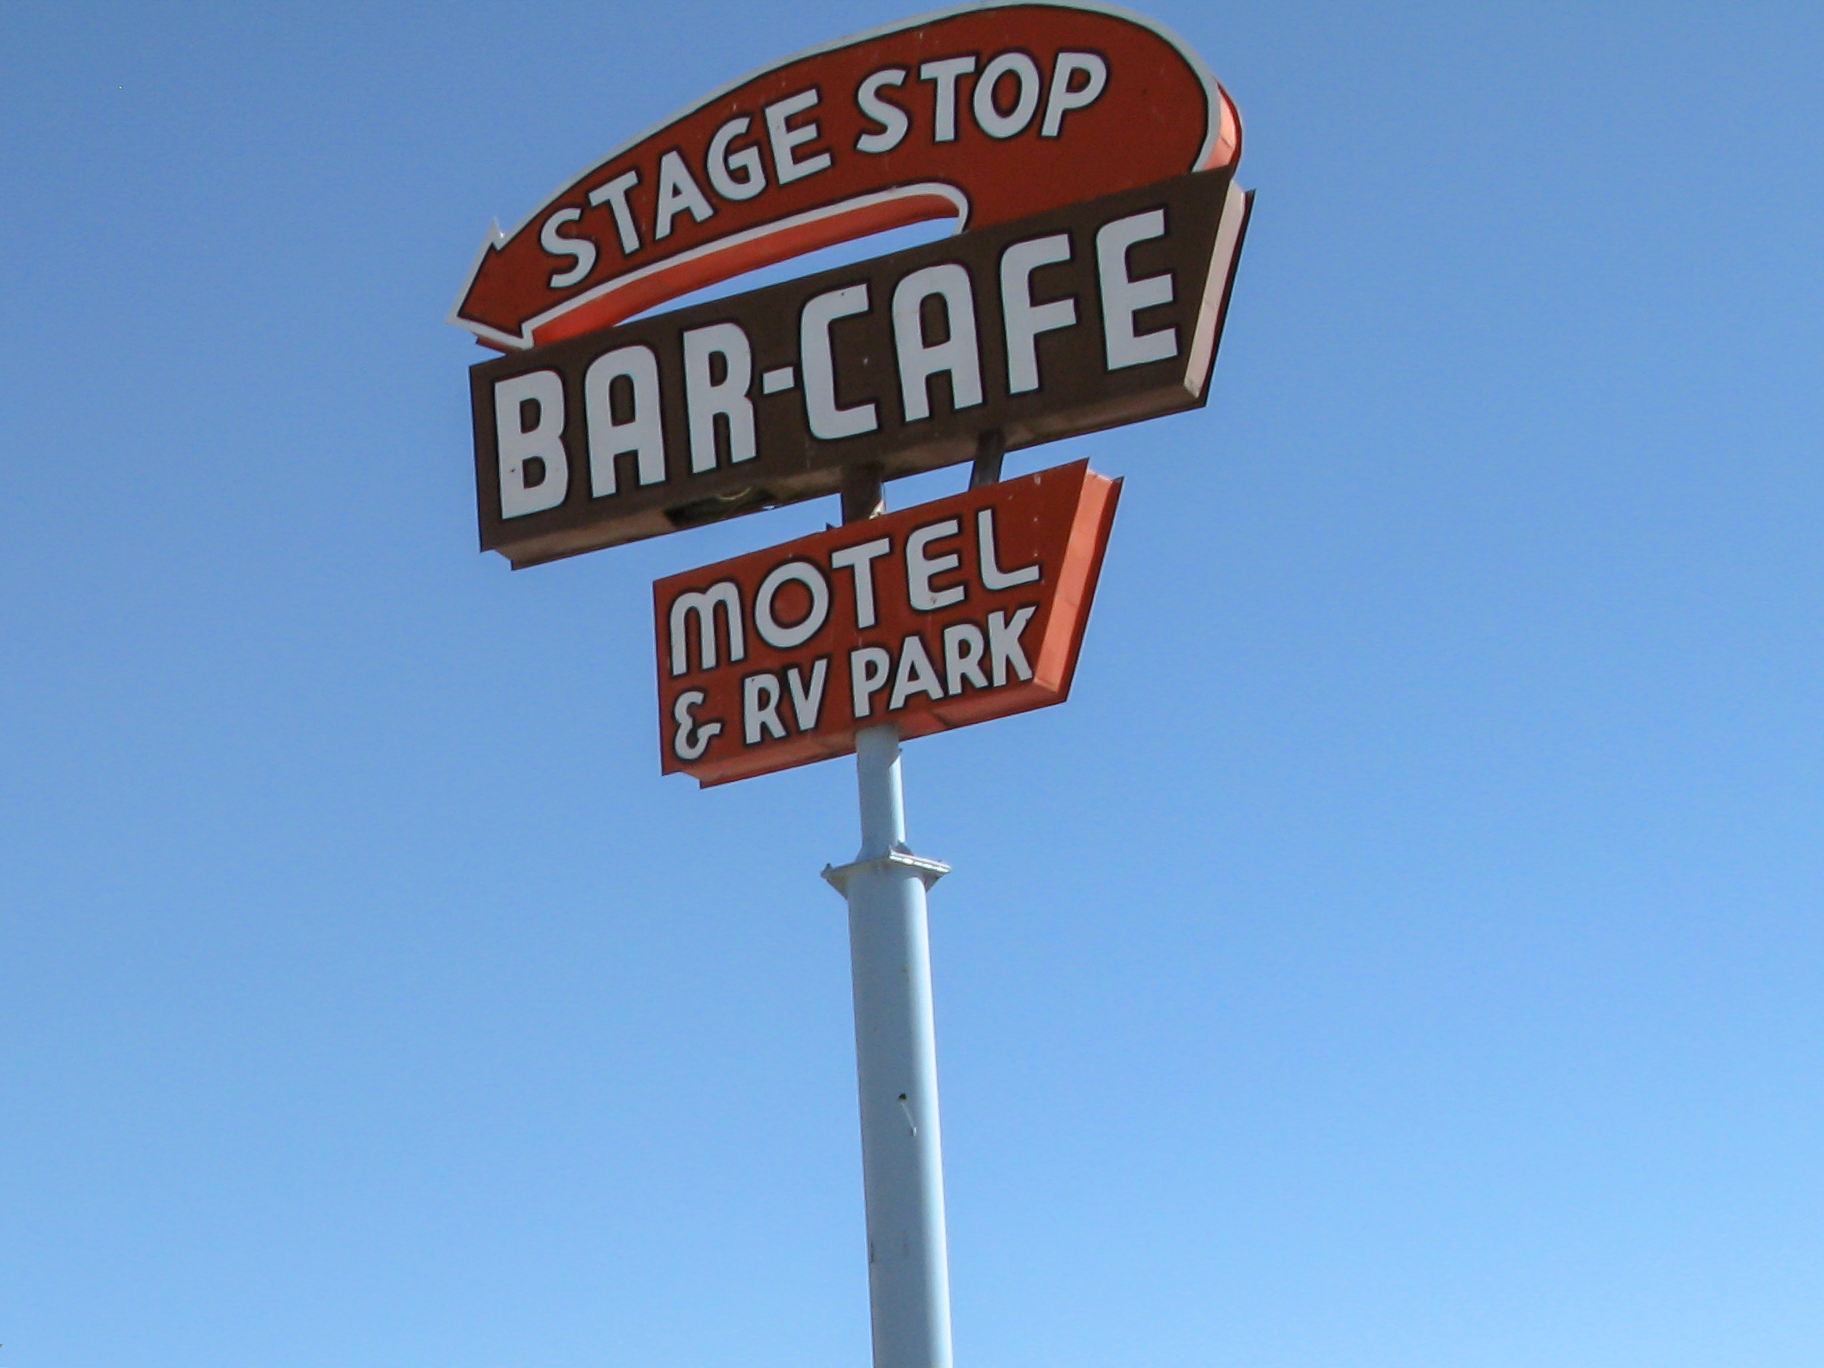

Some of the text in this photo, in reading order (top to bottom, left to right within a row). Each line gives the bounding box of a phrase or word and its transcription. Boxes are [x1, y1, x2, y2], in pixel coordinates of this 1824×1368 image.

[539, 52, 1107, 288] STAGE STOP
[492, 207, 1178, 520] BAR-CAFE
[668, 509, 1041, 677] MOTEL
[672, 606, 1037, 761] & RV PARK
